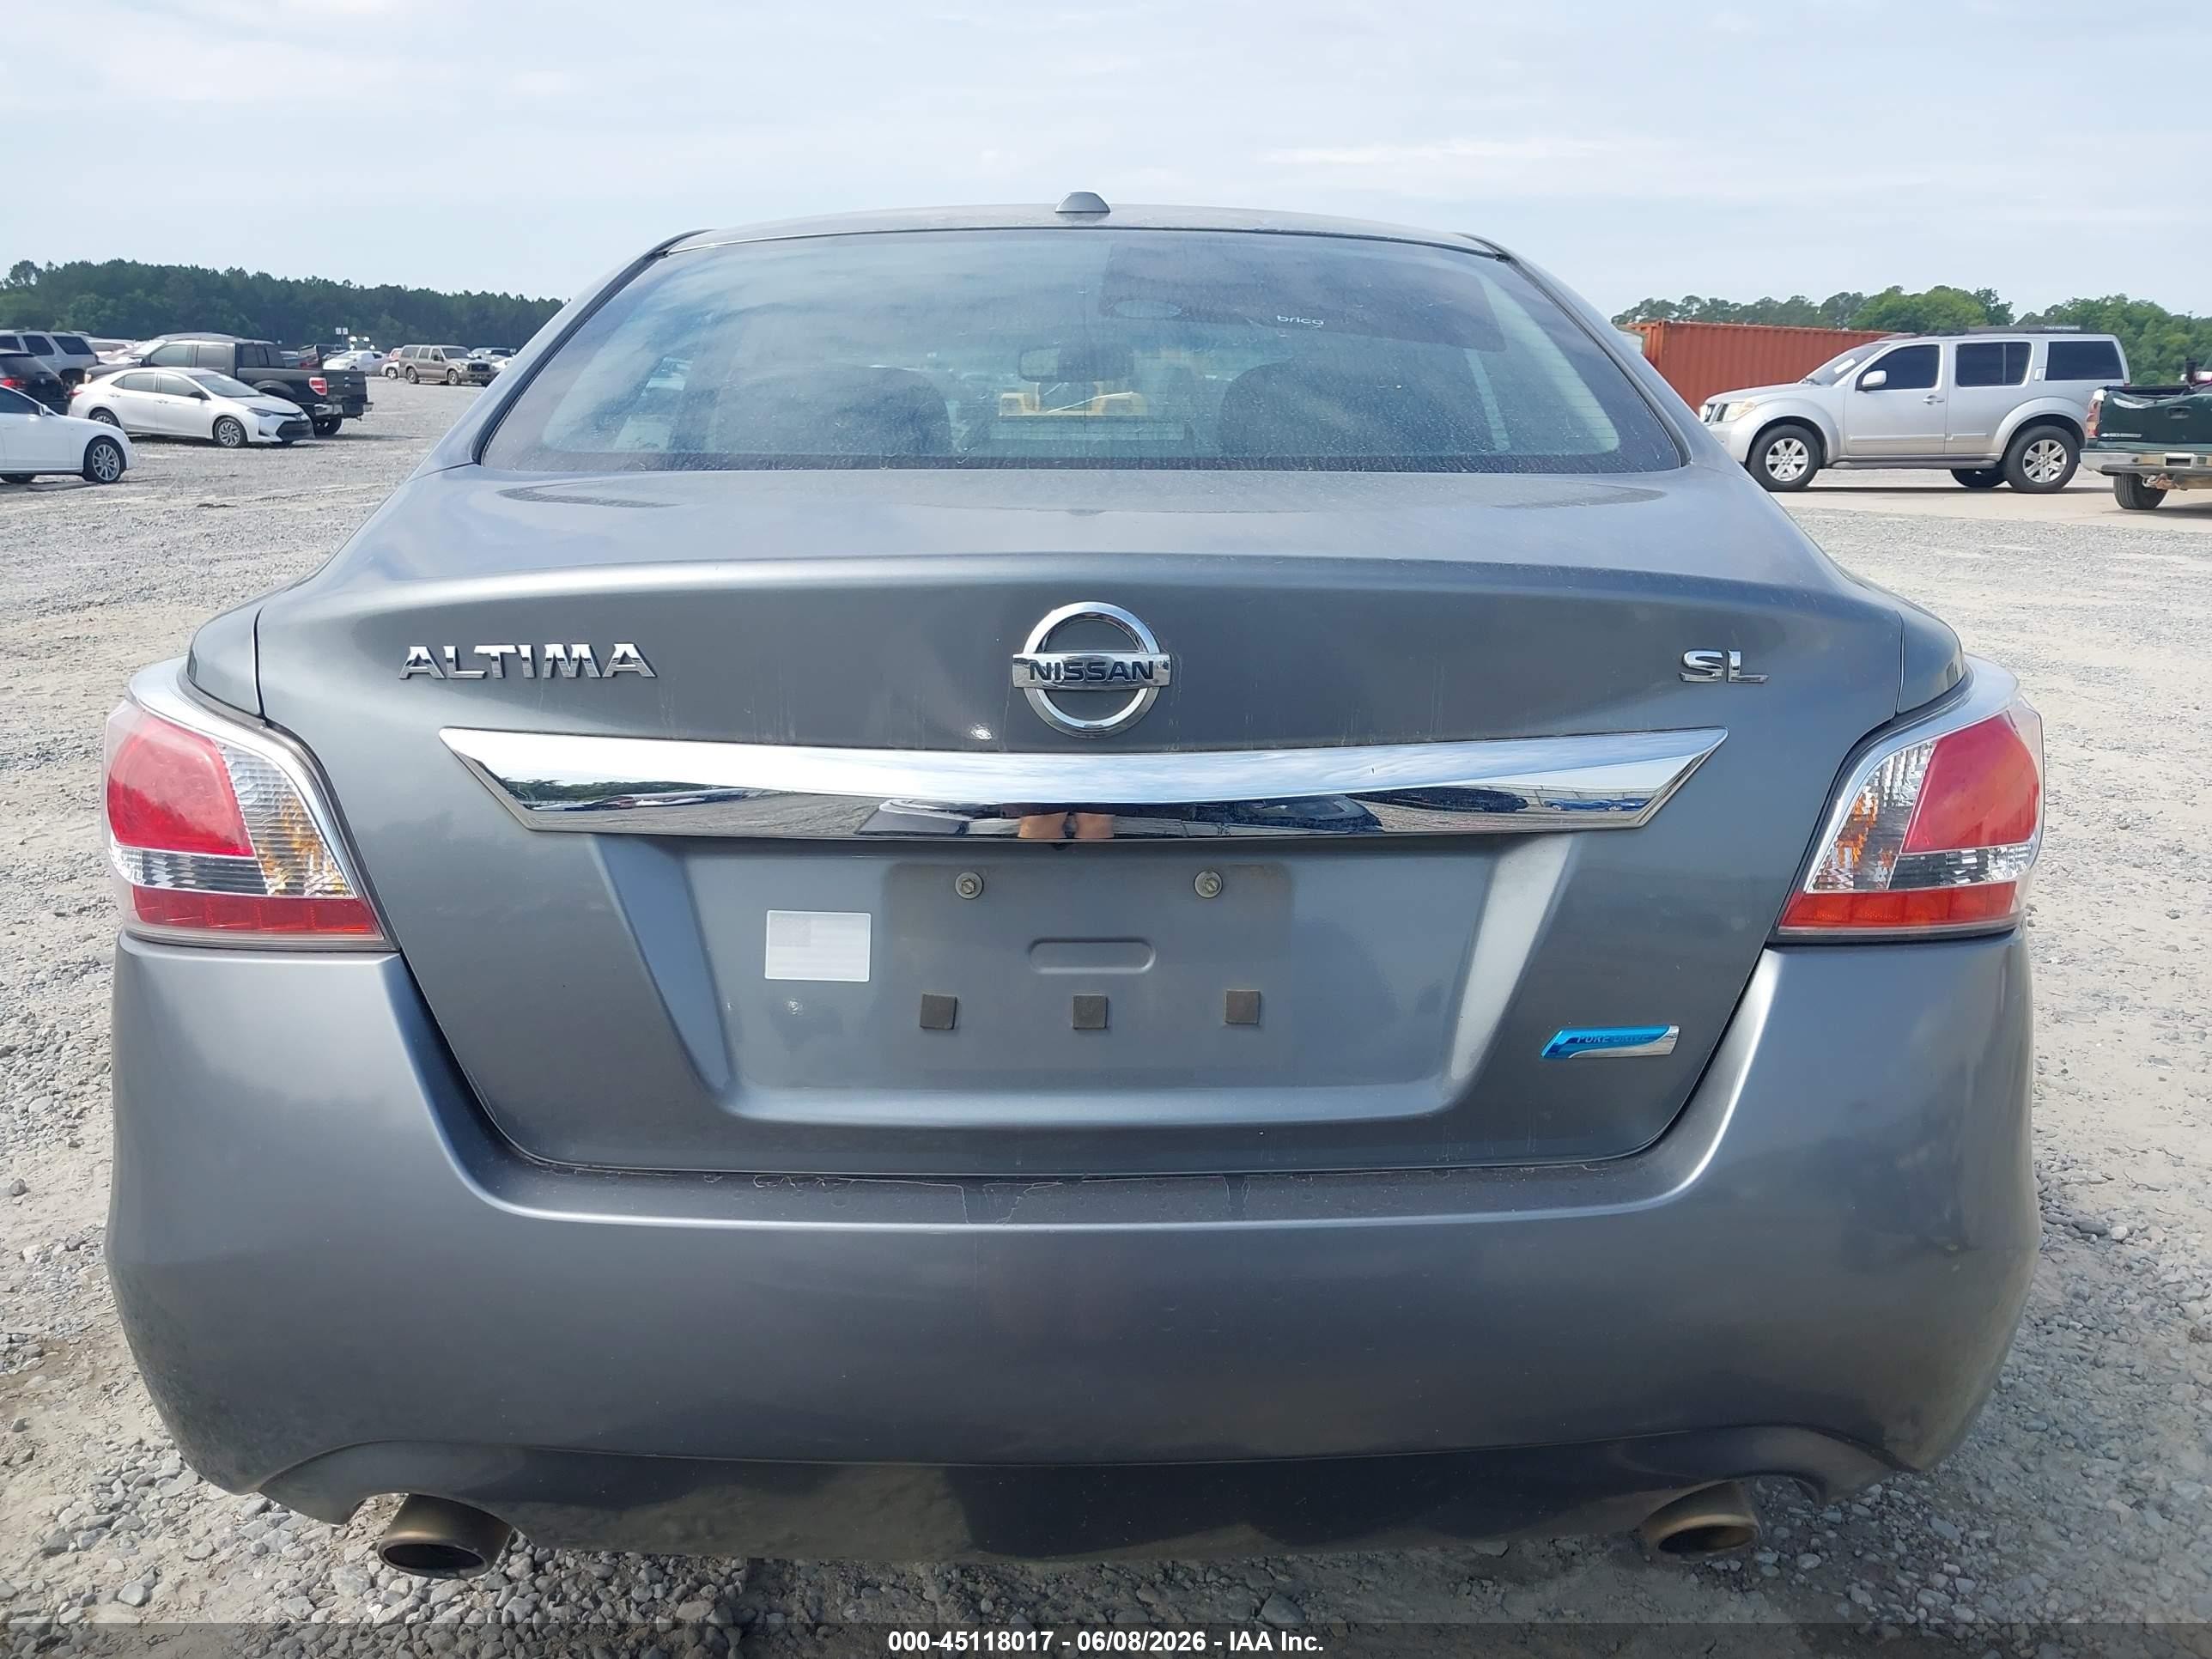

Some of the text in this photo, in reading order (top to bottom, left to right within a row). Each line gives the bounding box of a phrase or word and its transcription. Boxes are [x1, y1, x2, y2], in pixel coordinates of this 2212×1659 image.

[398, 642, 658, 679] ALTIMA
[1030, 660, 1154, 681] NISSAN
[1679, 649, 1770, 684] SL
